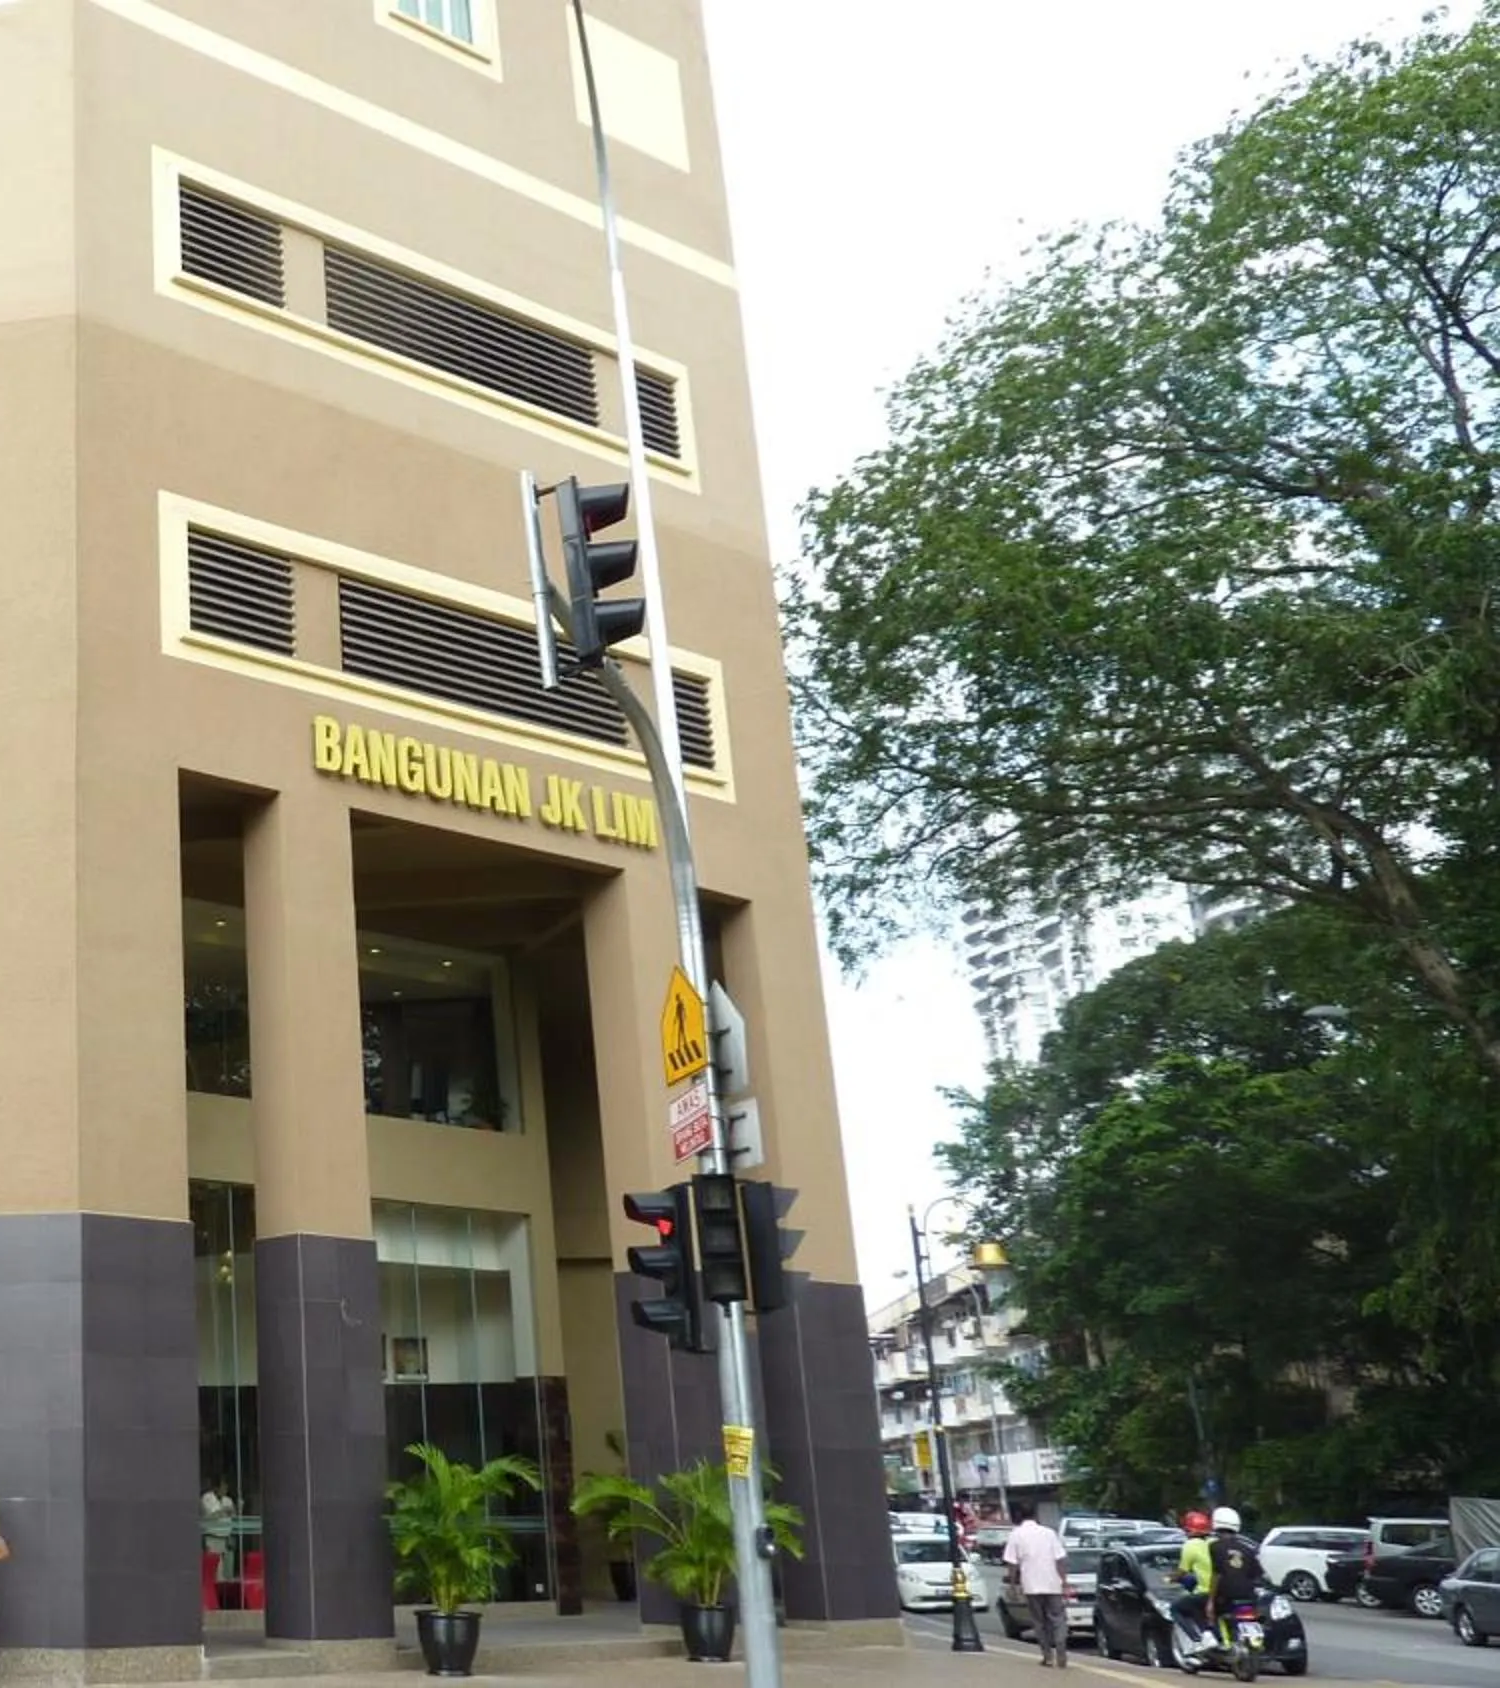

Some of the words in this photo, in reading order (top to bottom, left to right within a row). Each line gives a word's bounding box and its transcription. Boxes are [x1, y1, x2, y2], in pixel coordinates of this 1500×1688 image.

[313, 714, 532, 818] BANGUNAN
[541, 773, 587, 832] JK
[592, 785, 659, 848] LIM
